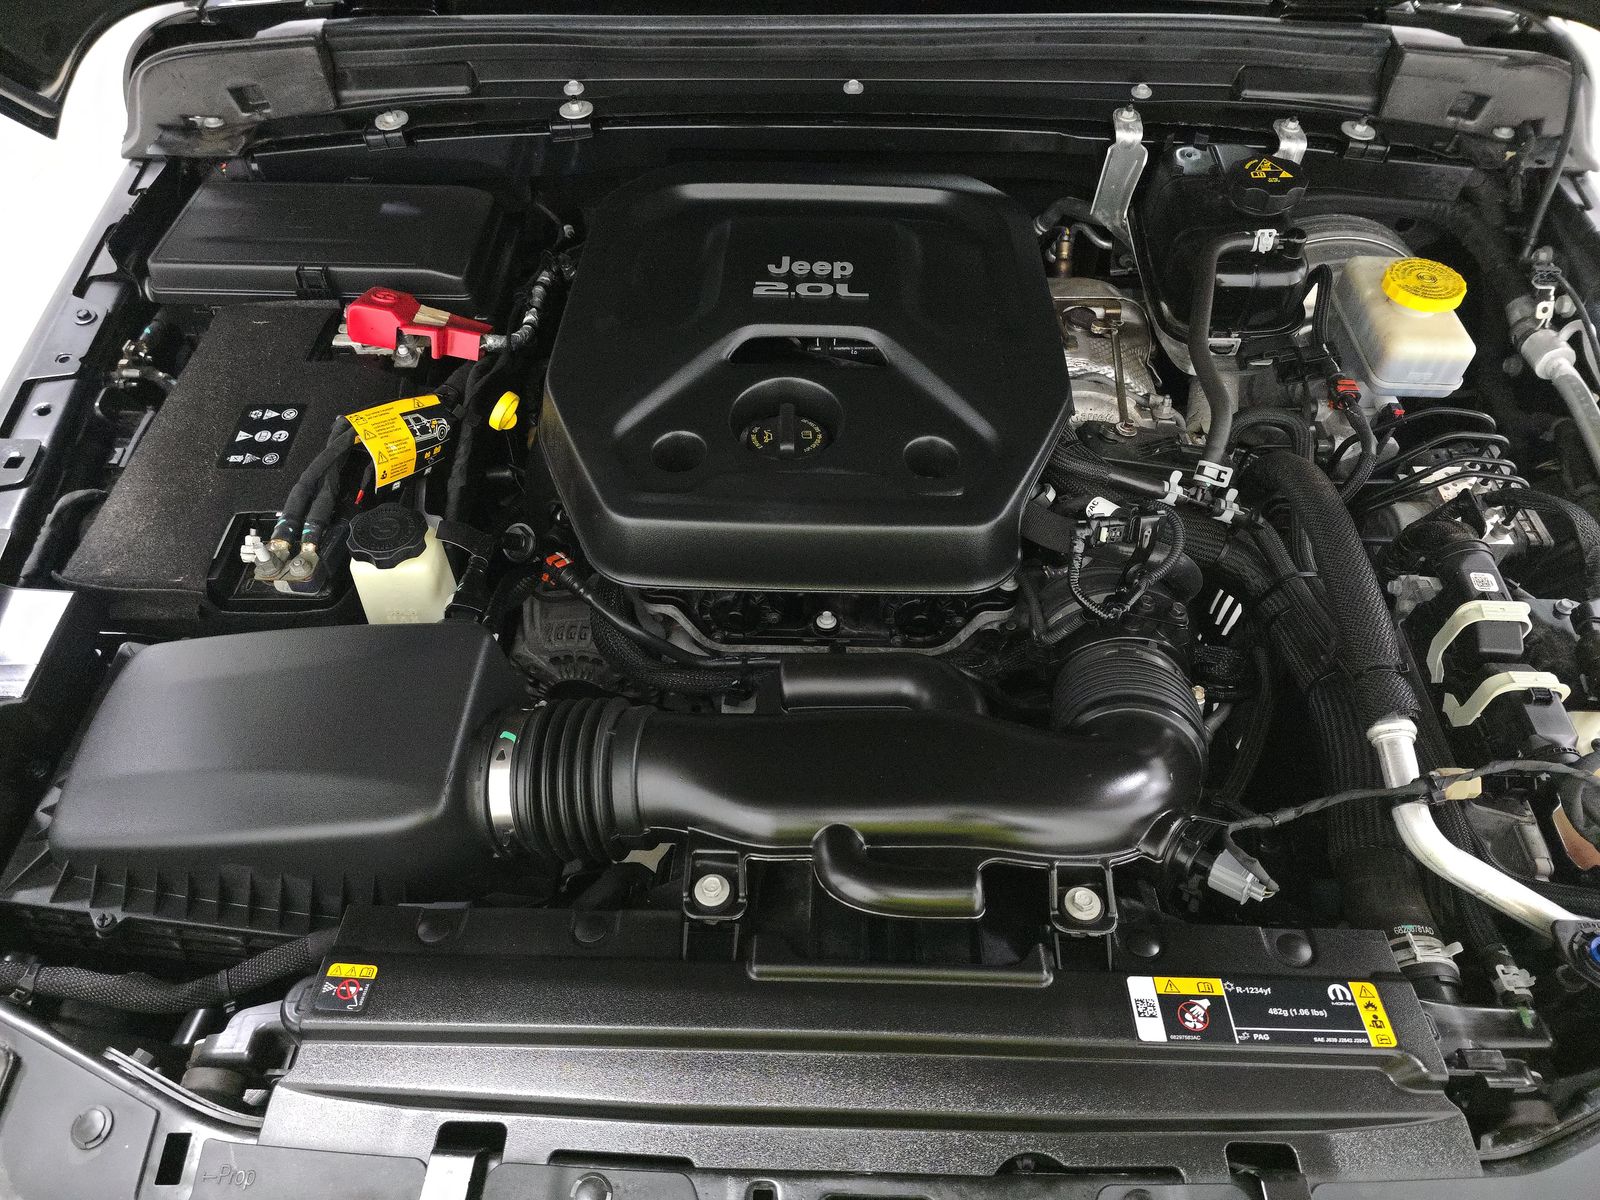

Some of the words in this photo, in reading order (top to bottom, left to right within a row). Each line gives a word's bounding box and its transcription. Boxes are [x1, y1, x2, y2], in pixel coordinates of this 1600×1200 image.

[767, 255, 854, 279] Jeep
[752, 281, 870, 298] 2.0L
[1235, 986, 1272, 996] R-1234yf
[1267, 1007, 1289, 1017] 482g
[1311, 1008, 1328, 1018] lbs)
[1252, 1033, 1270, 1041] PAG
[217, 1163, 257, 1191] Prop
